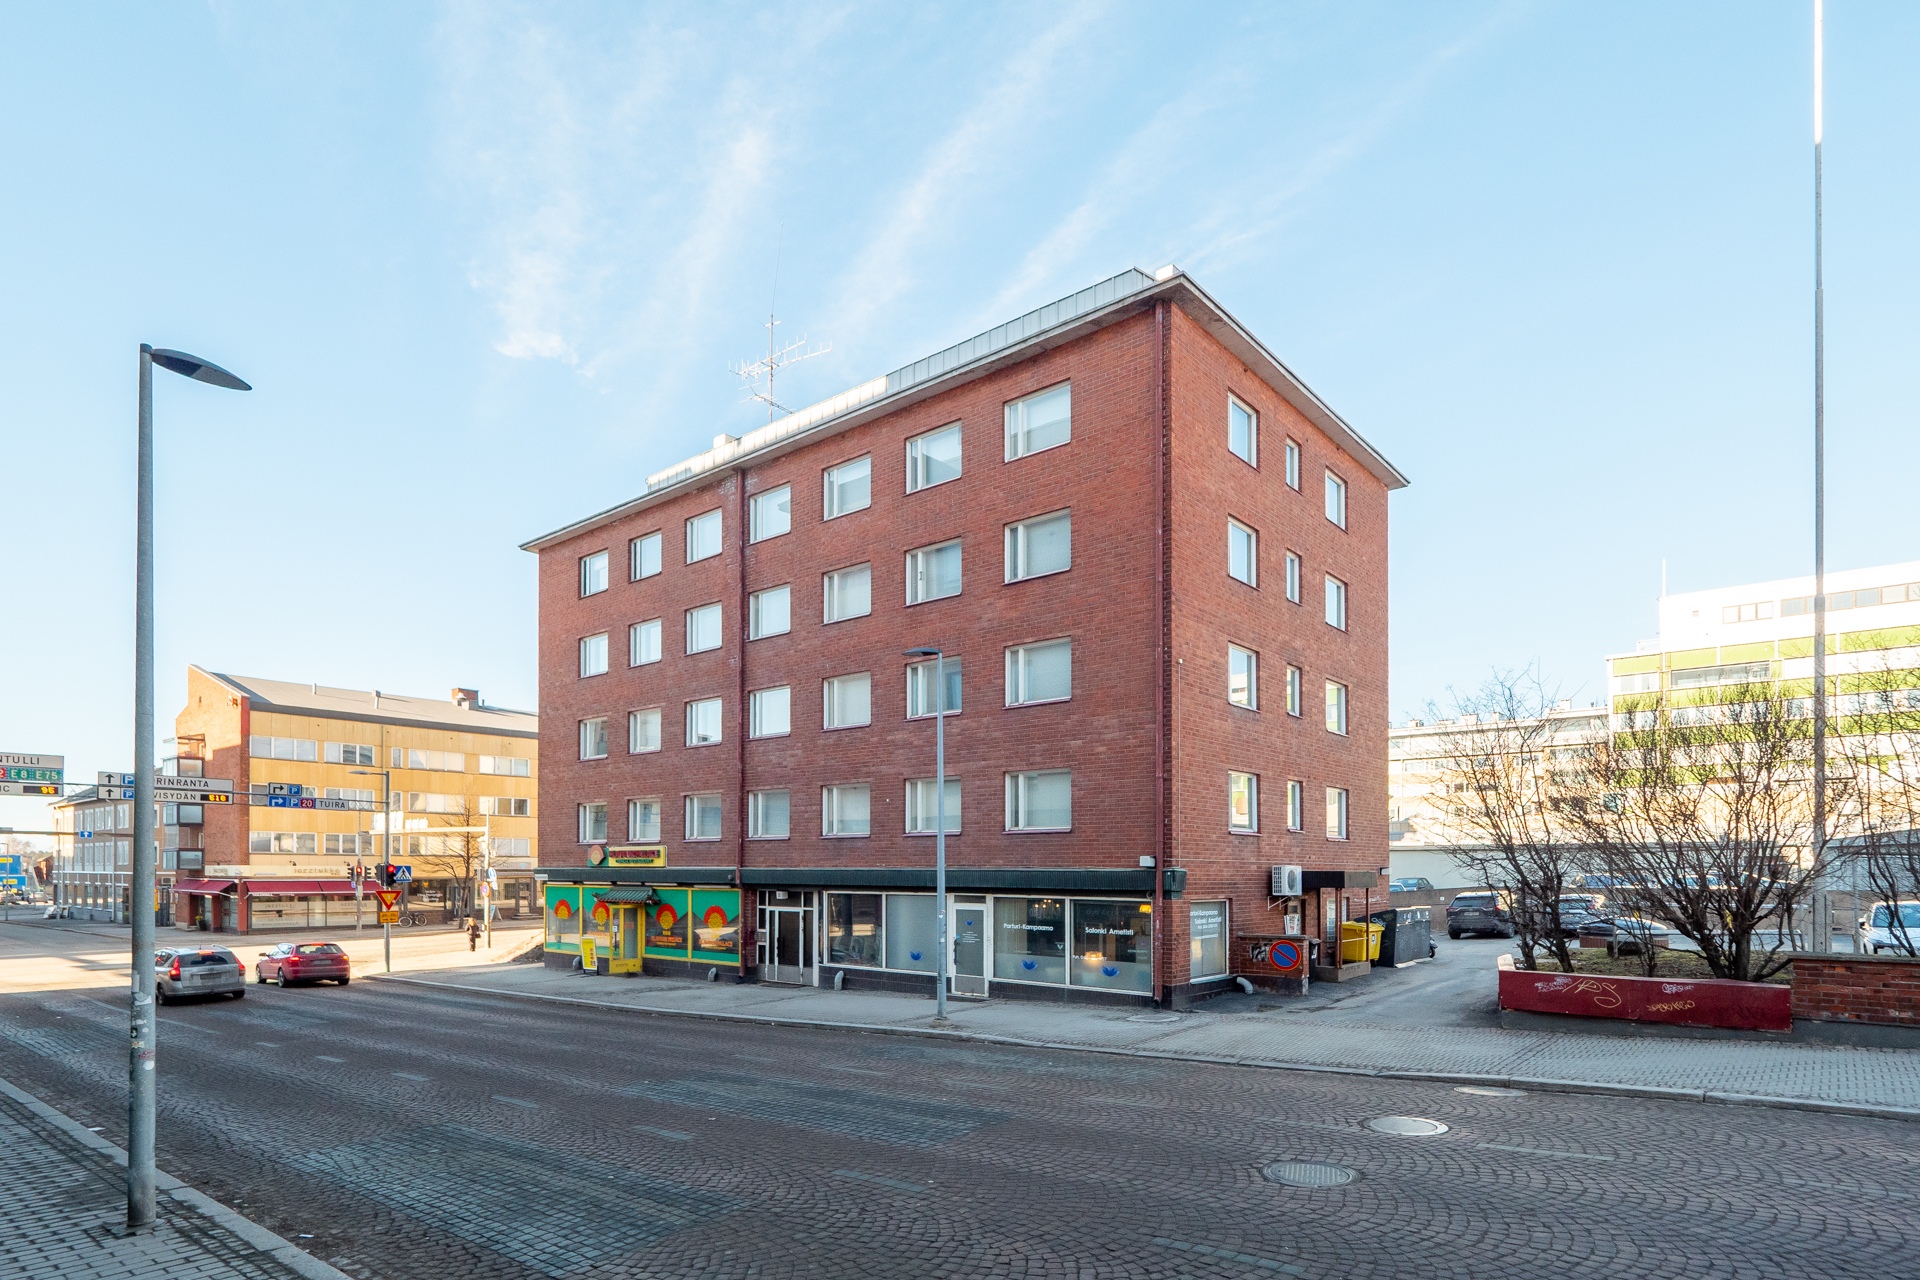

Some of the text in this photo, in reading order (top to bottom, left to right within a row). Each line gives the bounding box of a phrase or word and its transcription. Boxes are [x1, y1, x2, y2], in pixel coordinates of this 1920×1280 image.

[156, 777, 209, 788] RINRANTA
[154, 790, 196, 801] VISYDÄN
[291, 798, 346, 809] P 20 TUIRA
[1003, 922, 1054, 932] Parturi-Kampaamo
[1085, 926, 1134, 936] Salonki Ametisti
